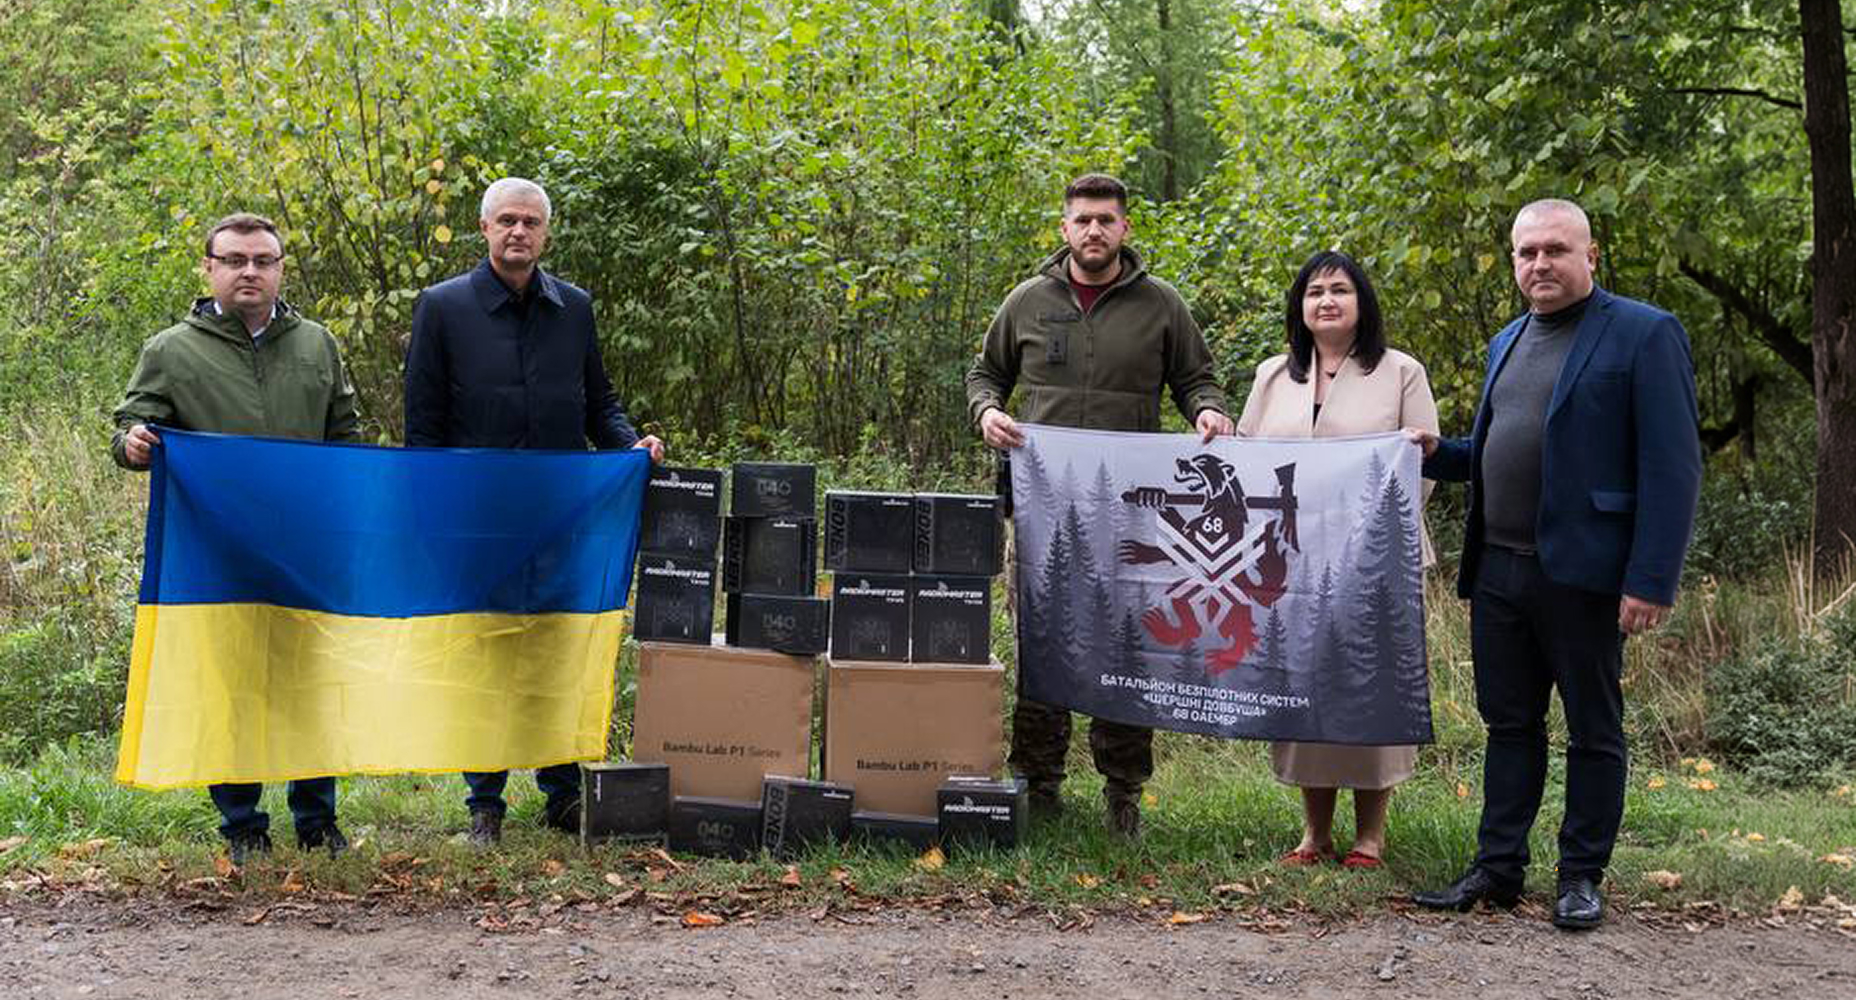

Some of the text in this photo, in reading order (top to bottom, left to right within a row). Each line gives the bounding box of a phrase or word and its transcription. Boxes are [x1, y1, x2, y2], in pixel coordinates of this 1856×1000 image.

[1202, 517, 1223, 533] 68
[1101, 674, 1310, 708] БАТАЛЬЙОН БЕЗПІЛОТНИХ СИСТЕМ
[1173, 708, 1189, 720] 68
[663, 741, 703, 754] Bambu
[706, 743, 727, 755] Lab
[730, 745, 745, 757] P1
[857, 760, 897, 771] Bambu
[899, 761, 920, 771] Lab
[923, 761, 938, 772] P1
